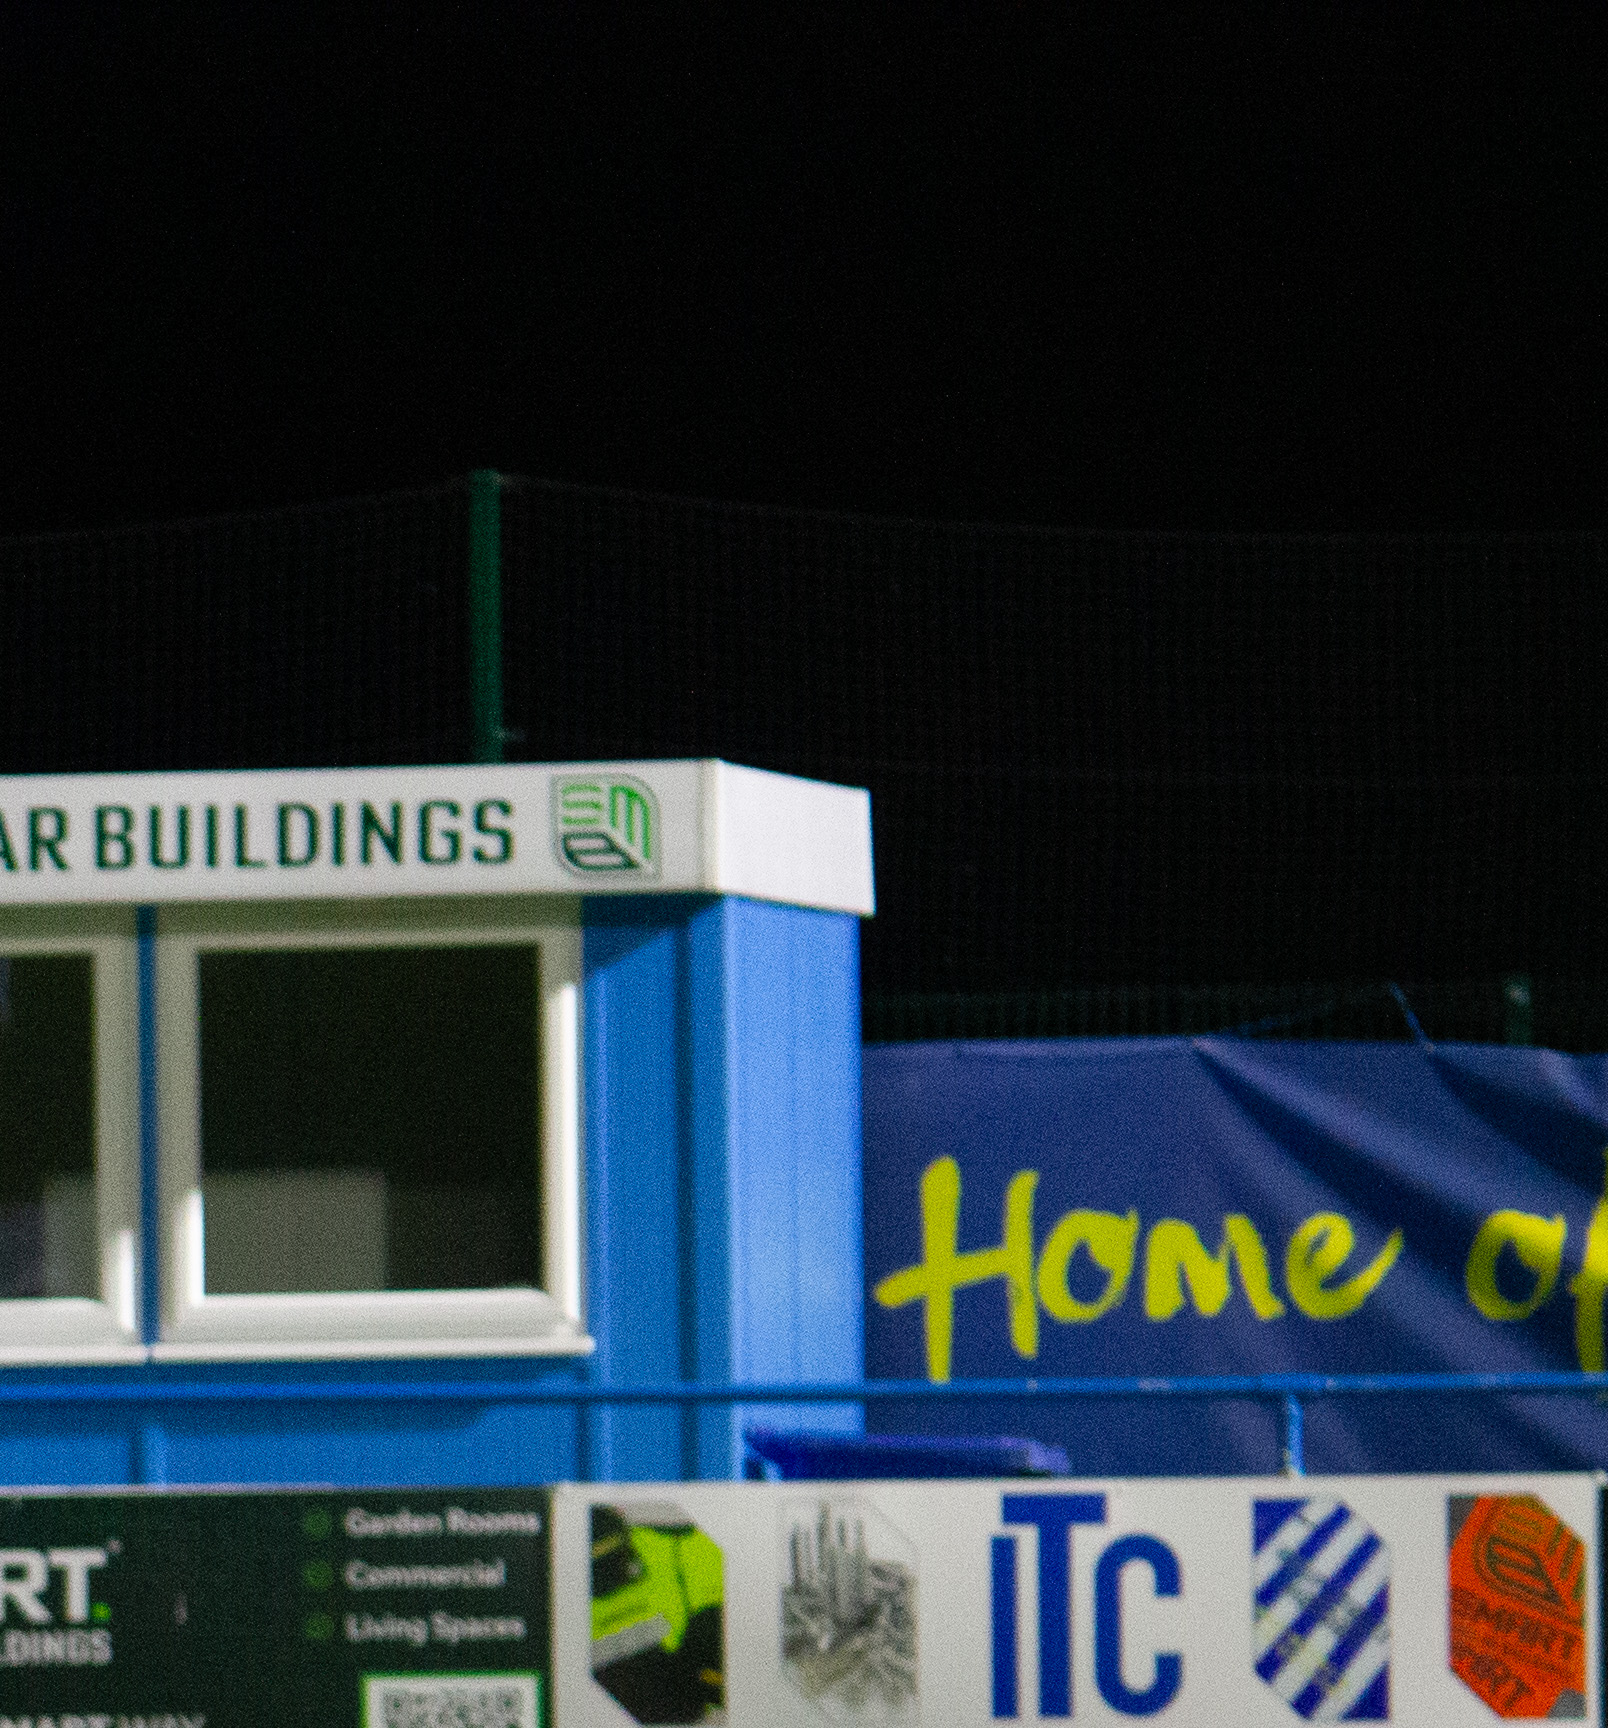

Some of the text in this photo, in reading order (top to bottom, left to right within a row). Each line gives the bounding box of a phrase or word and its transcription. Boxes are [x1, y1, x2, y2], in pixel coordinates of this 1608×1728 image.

[94, 799, 516, 872] BUILDINGS
[872, 1154, 1405, 1385] Home
[345, 1505, 542, 1538] Garden Rooms
[344, 1558, 506, 1589] Commercial
[344, 1610, 527, 1647] Living Spaces
